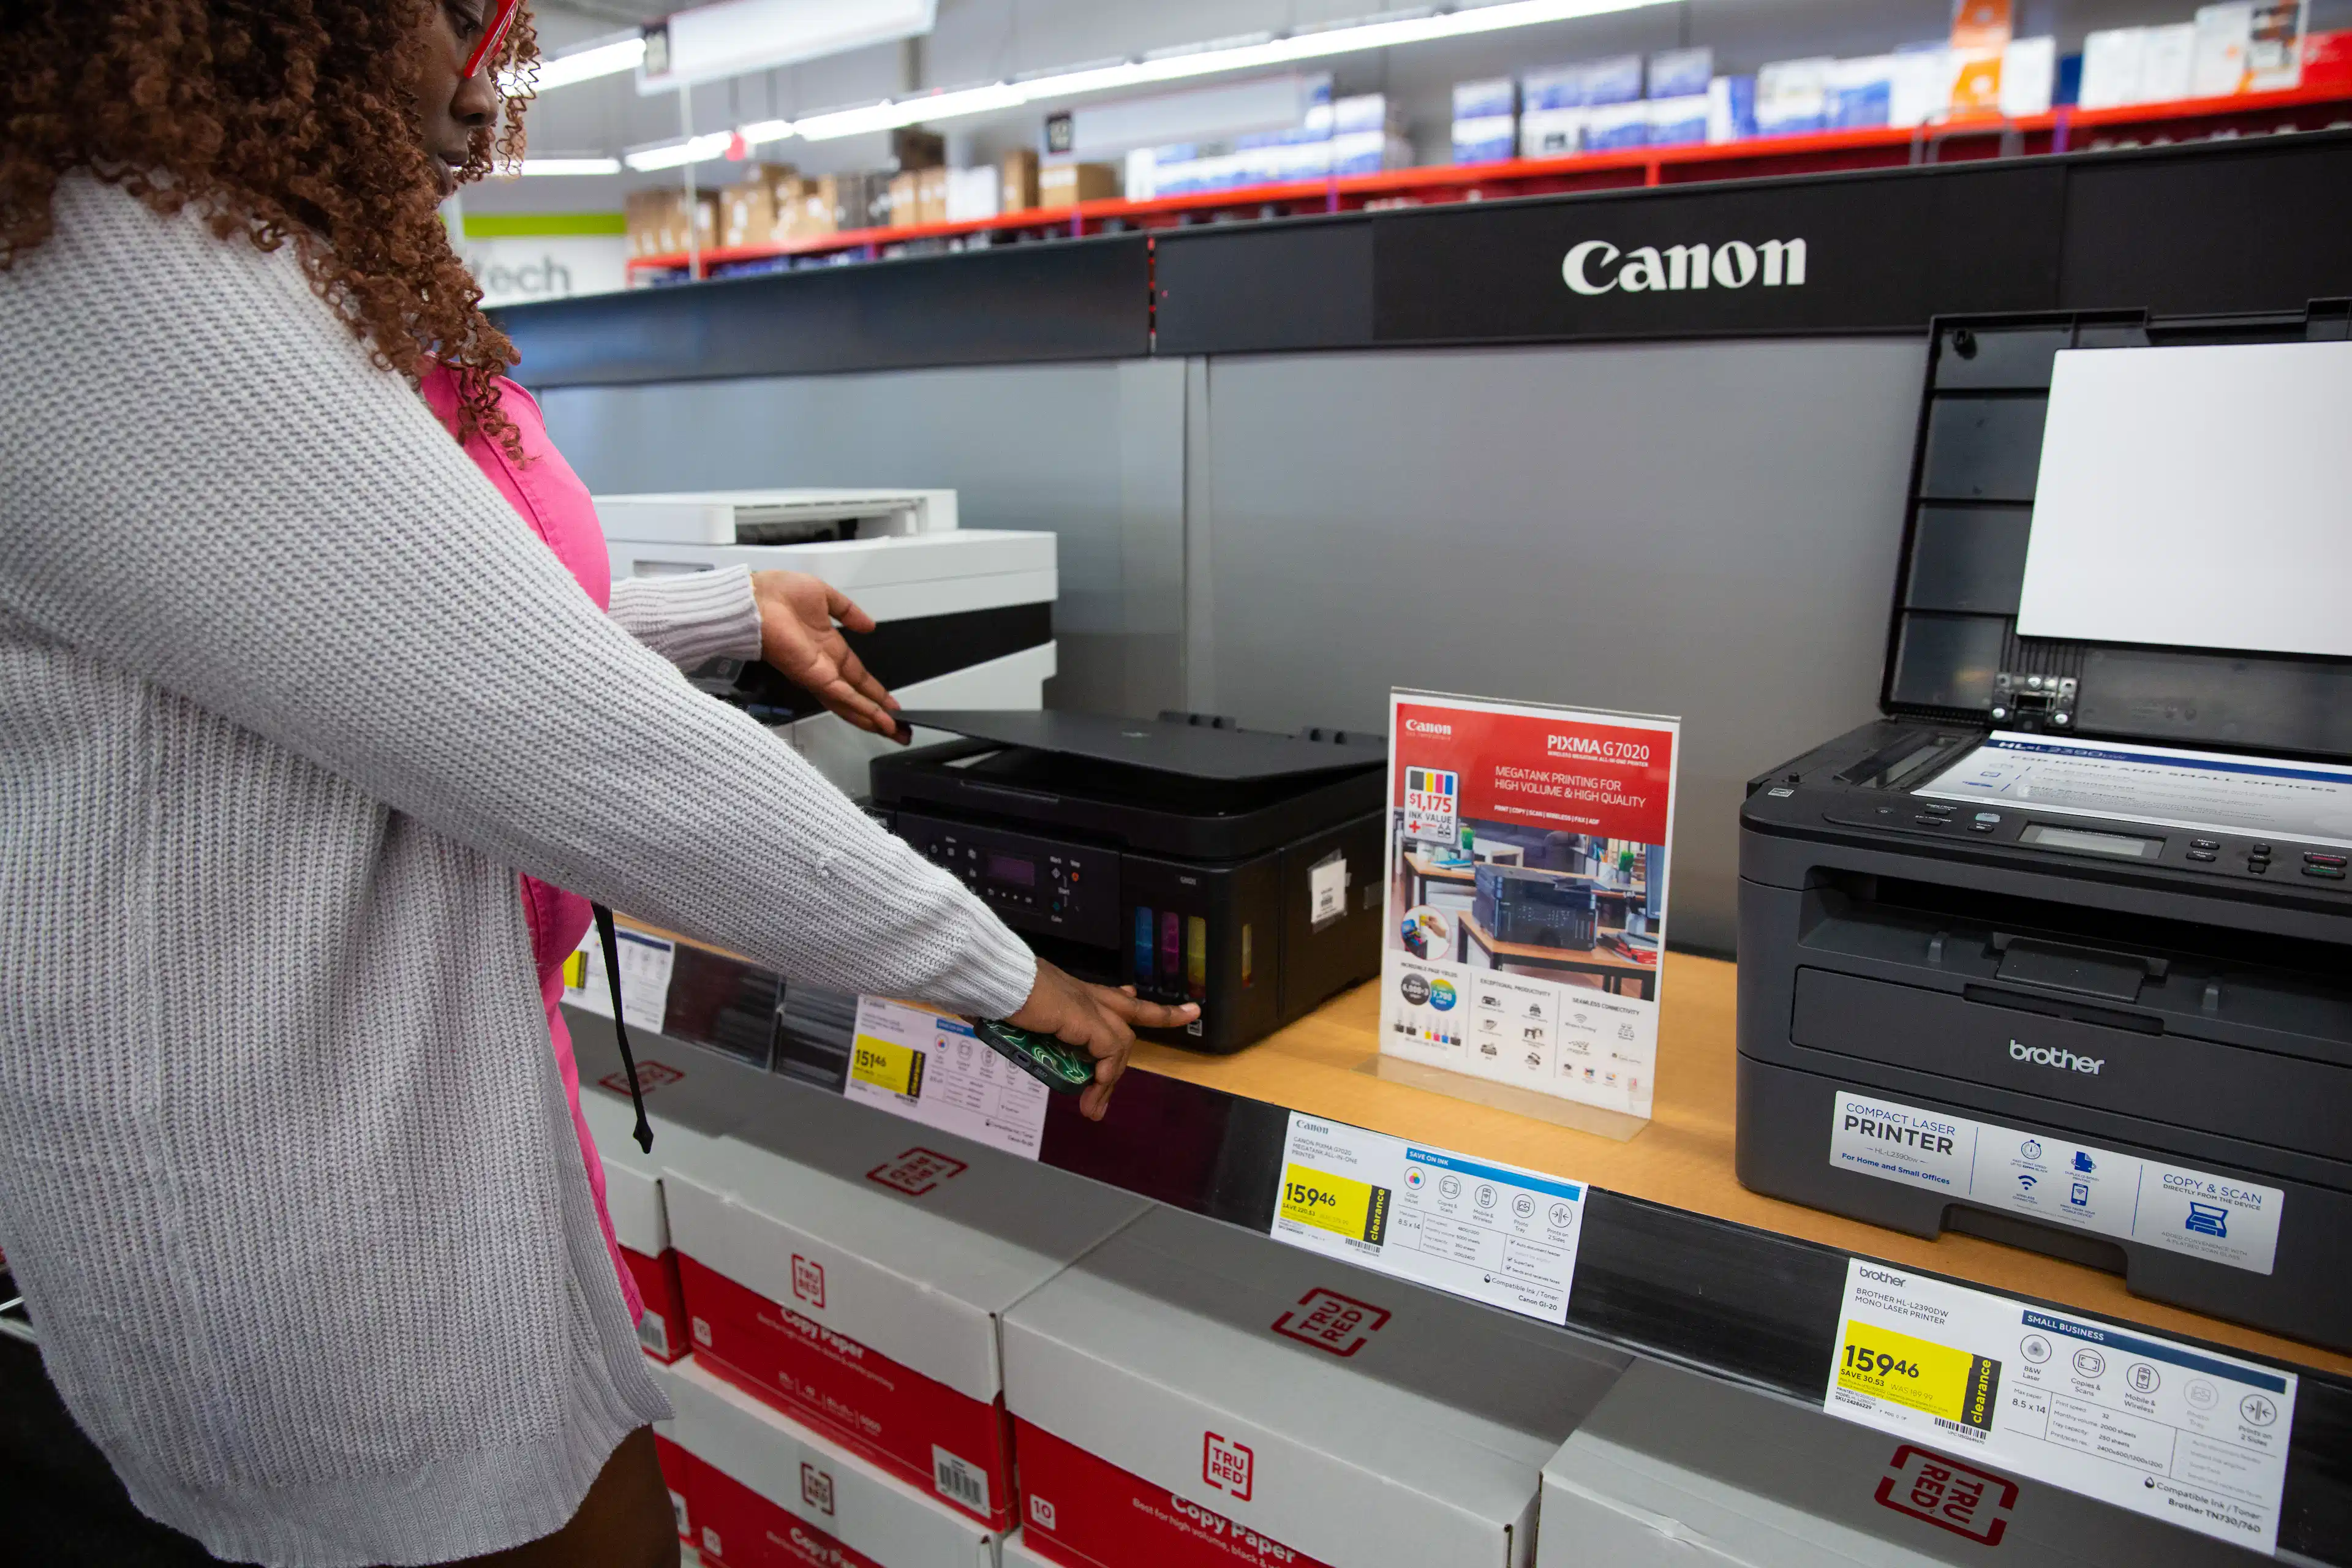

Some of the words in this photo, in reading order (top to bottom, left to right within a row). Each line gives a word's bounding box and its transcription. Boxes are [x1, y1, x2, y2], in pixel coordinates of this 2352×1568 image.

[1562, 238, 1806, 295] Canon
[1406, 720, 1452, 735] Canon
[1547, 734, 1601, 755] PIXMA
[1603, 741, 1649, 760] G7020
[1495, 766, 1550, 782] MEGATANK
[1551, 772, 1598, 789] PRINTING
[1600, 778, 1621, 791] FOR
[1409, 793, 1452, 813] $1,175
[1495, 778, 1518, 791] HIGH
[1521, 782, 1562, 797] VOLUME
[1564, 788, 1573, 799] &
[1574, 789, 1599, 802] HIGH
[1601, 792, 1646, 808] QUALITY
[1409, 810, 1422, 821] INK
[1425, 813, 1452, 825] VALUE
[1480, 978, 1512, 990] EXCEPTIONAL
[1514, 985, 1551, 997] PRODUCTIVITY
[1572, 997, 1600, 1008] SEAMLESS
[1602, 1003, 1640, 1016] CONNECTIVITY
[2009, 1039, 2105, 1075] brother
[1296, 1119, 1329, 1134] Canon
[1846, 1102, 1909, 1125] COMPACT
[1912, 1117, 1955, 1136] LASER
[1844, 1114, 1953, 1156] PRINTER
[1291, 1150, 1316, 1159] PRINTER
[1293, 1143, 1324, 1155] MEGATANK
[1324, 1152, 1358, 1164] ALL-IN-ONE
[1294, 1136, 1314, 1145] CANON
[1316, 1142, 1333, 1151] PIXMA
[1334, 1147, 1352, 1156] G7020
[1409, 1151, 1425, 1159] SAVE
[1874, 1147, 1919, 1163] HL-L2390DW
[1842, 1153, 1855, 1161] For
[1856, 1156, 1879, 1167] Home
[1881, 1162, 1896, 1171] and
[1898, 1166, 1920, 1177] Small
[1921, 1172, 1950, 1185] Offices
[2163, 1174, 2203, 1189] COPY
[2207, 1183, 2216, 1193] &
[2221, 1187, 2262, 1204] SCAN
[2163, 1183, 2195, 1196] DIRECTLY
[2197, 1191, 2217, 1200] FROM
[2234, 1200, 2261, 1210] DEVICE
[1283, 1202, 1297, 1212] SAVE
[1297, 1207, 1316, 1216] 220.53
[1370, 1188, 1385, 1241] clearance
[1437, 1200, 1453, 1208] Copies
[1473, 1208, 1490, 1218] Mobile
[1472, 1215, 1493, 1224] Wireless
[1513, 1219, 1529, 1227] Photo
[1547, 1227, 1561, 1236] Prints
[1551, 1235, 1565, 1243] Sides
[1526, 1244, 1547, 1254] document
[2162, 1231, 2182, 1240] ADDED
[2184, 1236, 2230, 1252] CONVENIENCE
[2231, 1248, 2247, 1256] WITH
[2172, 1239, 2199, 1250] FLATBED
[2201, 1246, 2218, 1255] SCAN
[1859, 1266, 1906, 1287] brother
[1491, 1277, 1525, 1292] Compatible
[1540, 1291, 1559, 1302] Toner:
[1518, 1294, 1537, 1305] Canon
[1539, 1301, 1558, 1311] GI-20
[1855, 1295, 1882, 1308] MONO
[1883, 1303, 1909, 1316] LASER
[1910, 1310, 1945, 1325] PRINTER
[1856, 1287, 1894, 1303] BROTHER
[1896, 1298, 1949, 1317] HL-L2390DW
[1297, 1300, 1342, 1331] TRU
[780, 1307, 819, 1339] Copy
[821, 1327, 865, 1359] Paper
[1319, 1310, 1363, 1343] RED
[2027, 1315, 2057, 1329] SMALL
[2059, 1323, 2104, 1341] BUSINESS
[1845, 1344, 1919, 1378] 15946
[2024, 1365, 2041, 1374] B&W
[1841, 1368, 1861, 1380] SAVE
[1863, 1375, 1884, 1387] 30.53
[1891, 1384, 1909, 1394] WAS
[2022, 1373, 2040, 1382] Laser
[2071, 1378, 2094, 1389] Copies
[1970, 1359, 1991, 1423] clearance
[2075, 1386, 2094, 1396] Scans
[2125, 1393, 2149, 1404] Mobile
[1847, 1398, 1872, 1410] 24286229
[2012, 1398, 2027, 1408] 8.5
[2036, 1404, 2046, 1414] 14
[2124, 1400, 2154, 1414] Wireless
[2054, 1411, 2076, 1422] Monthly
[2100, 1423, 2117, 1433] 2000
[2118, 1430, 2136, 1439] sheets
[2239, 1425, 2261, 1436] Prints
[2111, 1437, 2130, 1448] sheets
[2247, 1436, 2267, 1447] Sides
[1213, 1447, 1244, 1471] TRU
[1212, 1460, 1243, 1484] RED
[1910, 1463, 1952, 1508] RED
[2157, 1481, 2209, 1504] Compatible
[2211, 1498, 2225, 1510] Ink
[1034, 1499, 1052, 1520] 10
[1942, 1478, 1985, 1525] TRU
[2168, 1498, 2204, 1515] Brother
[2205, 1509, 2261, 1533] TN730/760
[1133, 1497, 1154, 1515] Best
[1155, 1508, 1169, 1522] for
[1169, 1515, 1191, 1532] high
[1231, 1544, 1257, 1565] black
[1170, 1494, 1226, 1534] Copy
[1231, 1521, 1296, 1563] Paper
[790, 1527, 828, 1561] Copy
